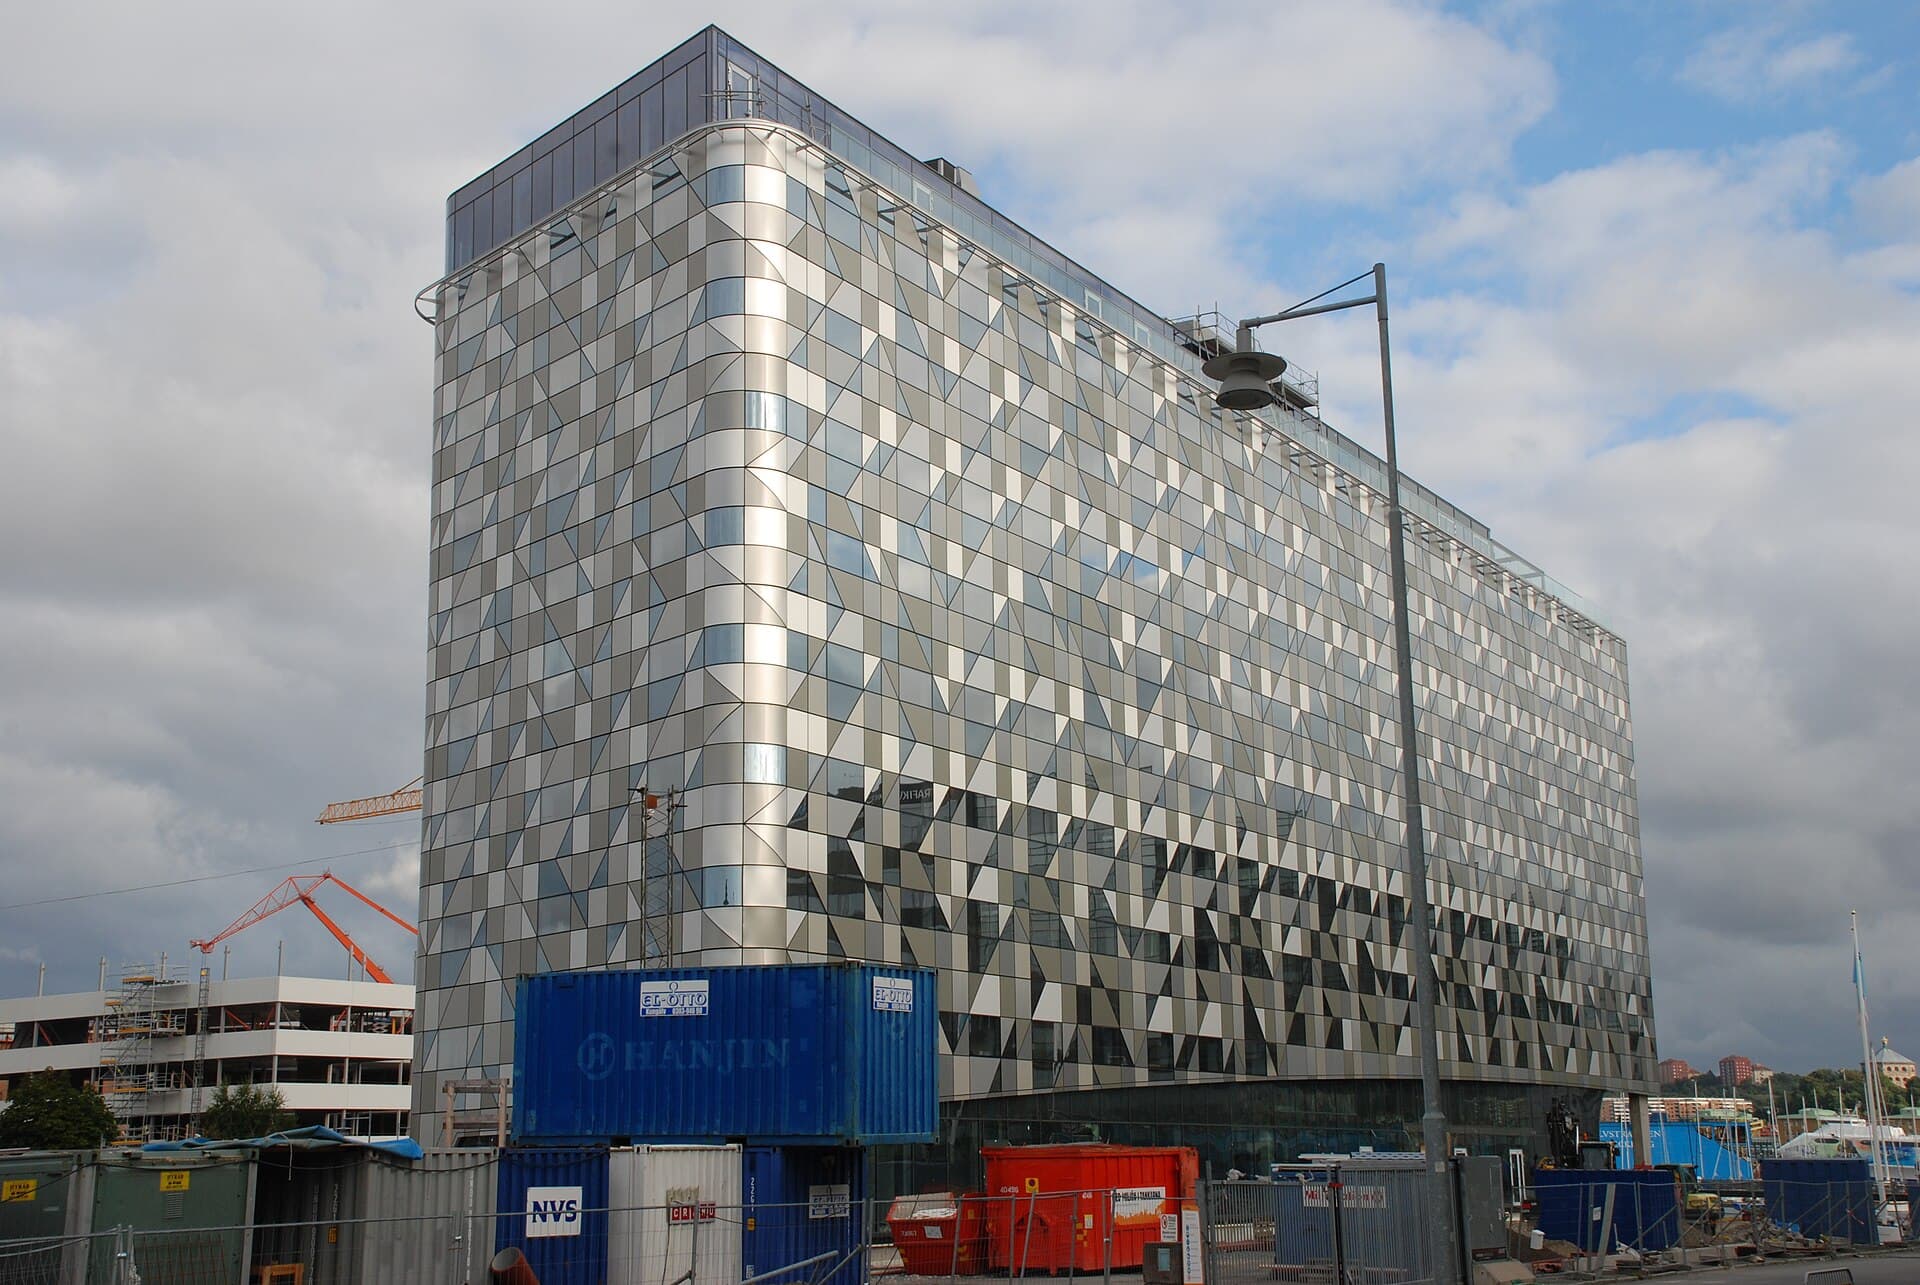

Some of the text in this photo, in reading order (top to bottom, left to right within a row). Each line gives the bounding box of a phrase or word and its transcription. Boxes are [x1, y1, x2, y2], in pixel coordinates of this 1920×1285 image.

[641, 993, 707, 1007] EL-OTTO
[624, 1038, 790, 1073] HANJIN
[532, 1200, 577, 1223] NVS
